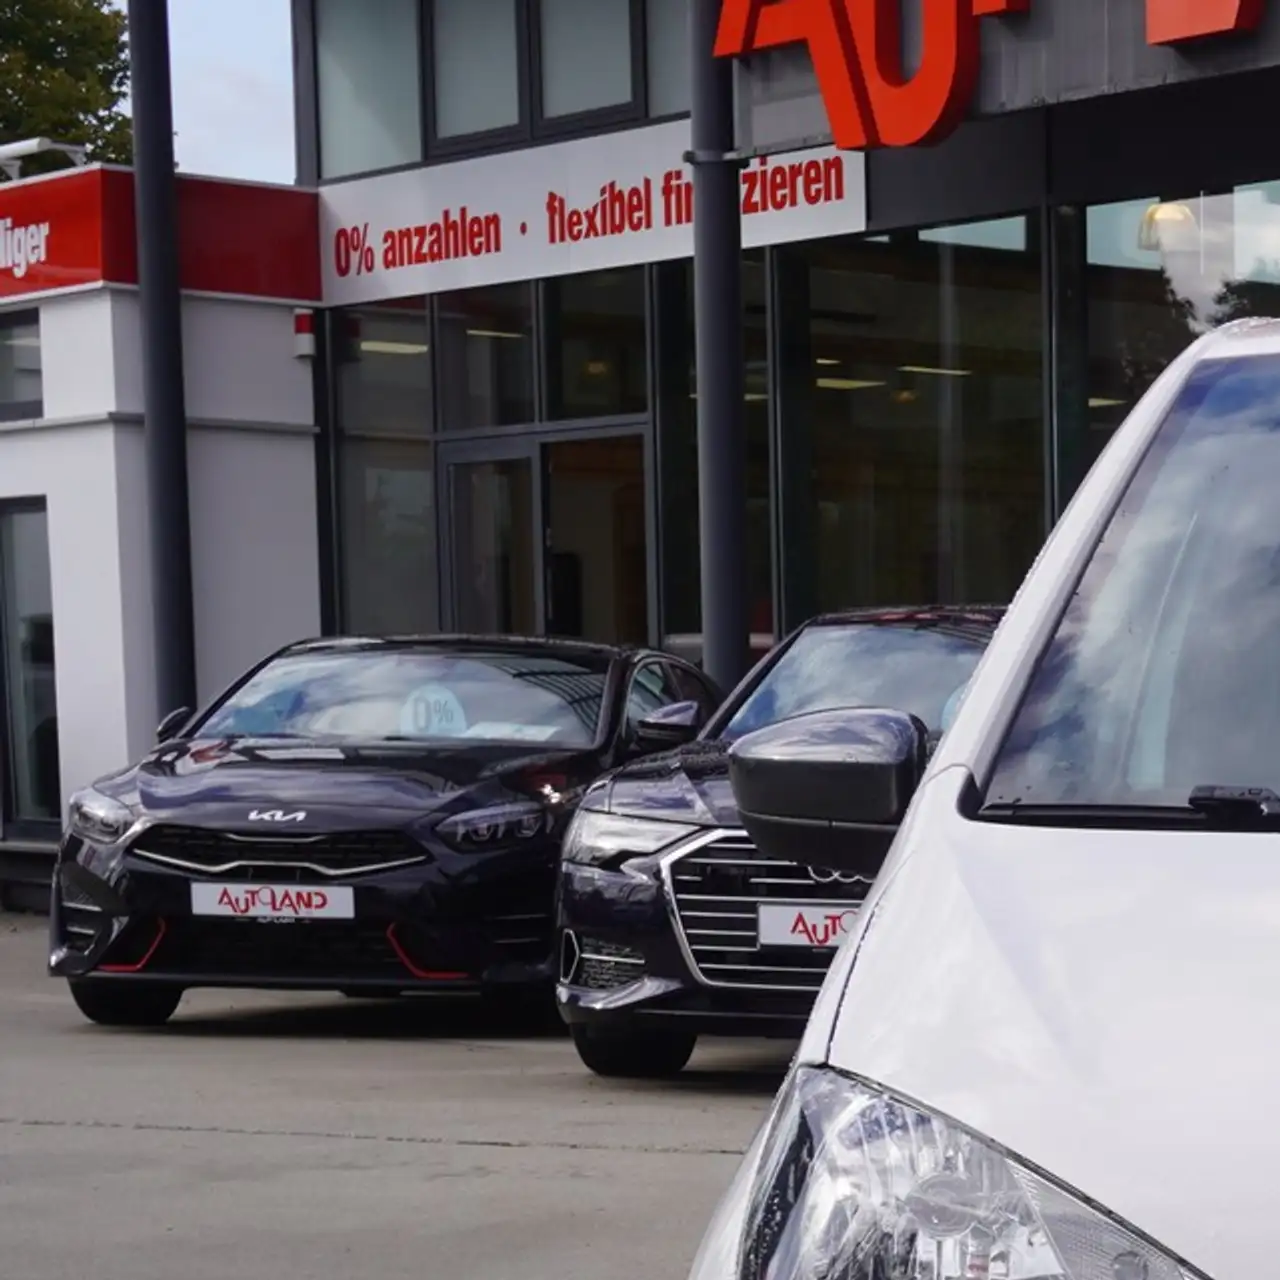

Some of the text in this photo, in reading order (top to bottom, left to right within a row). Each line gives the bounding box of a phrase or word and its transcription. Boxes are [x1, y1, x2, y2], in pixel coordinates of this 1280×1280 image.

[334, 154, 844, 277] 0% anzahlen flexibel finzieren
[218, 885, 328, 915] AUTOLAND
